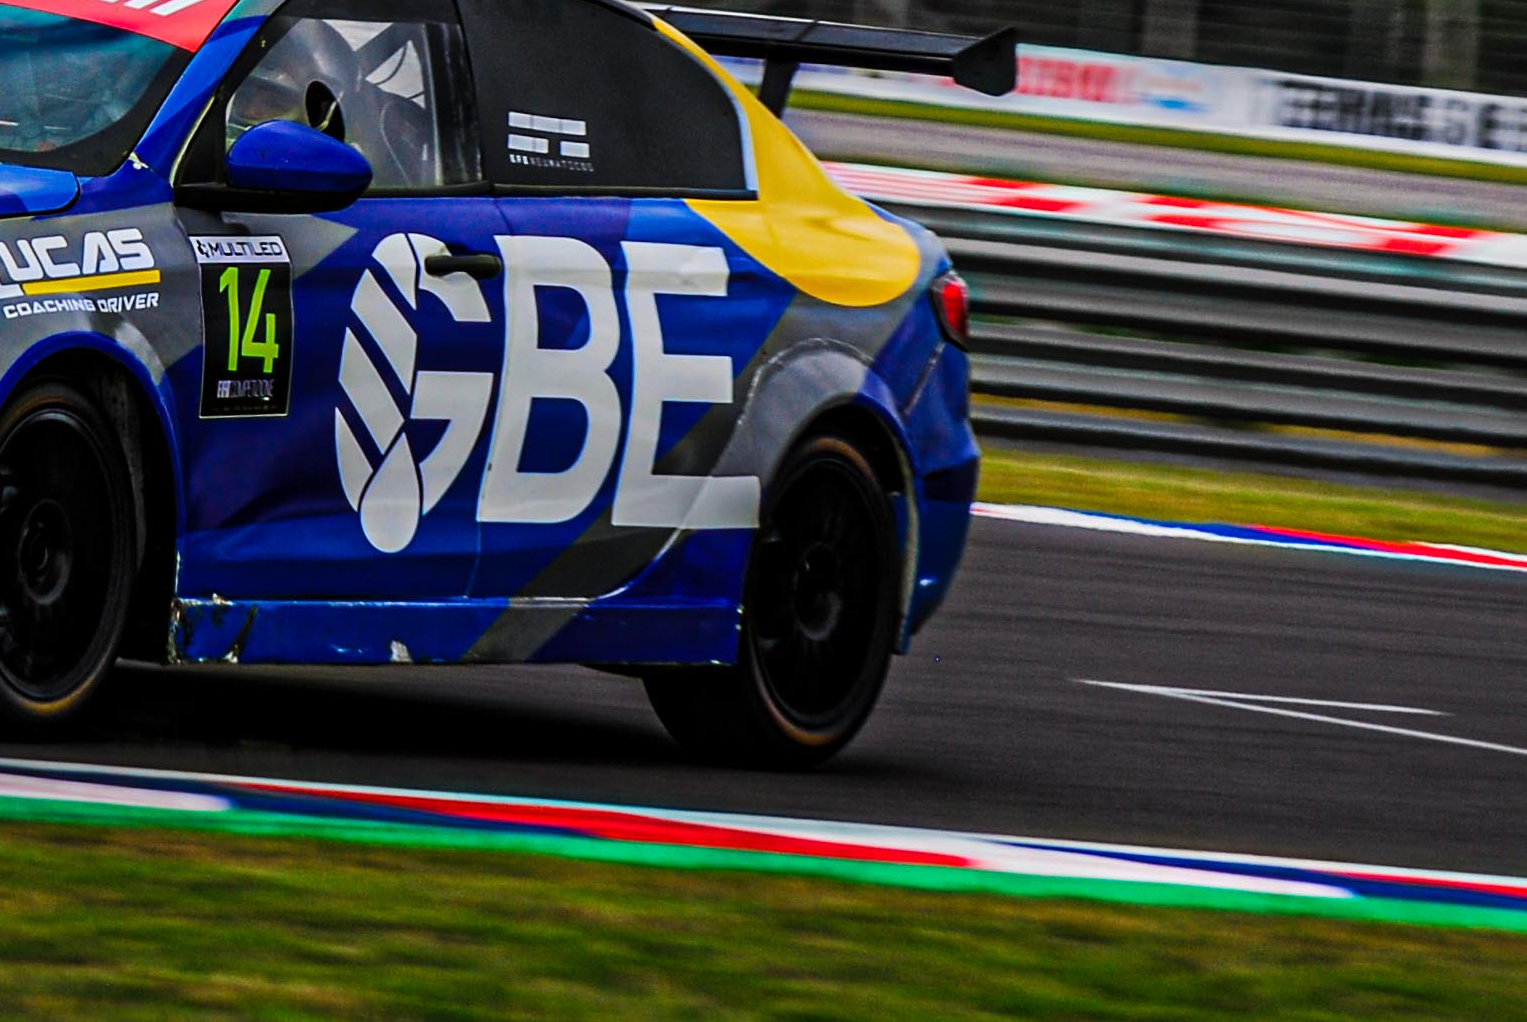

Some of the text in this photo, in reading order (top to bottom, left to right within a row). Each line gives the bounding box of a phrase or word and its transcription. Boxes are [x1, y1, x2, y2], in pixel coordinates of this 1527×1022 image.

[208, 241, 284, 257] MULTILED
[2, 292, 160, 319] COACHING DRIVER
[219, 266, 280, 374] 14
